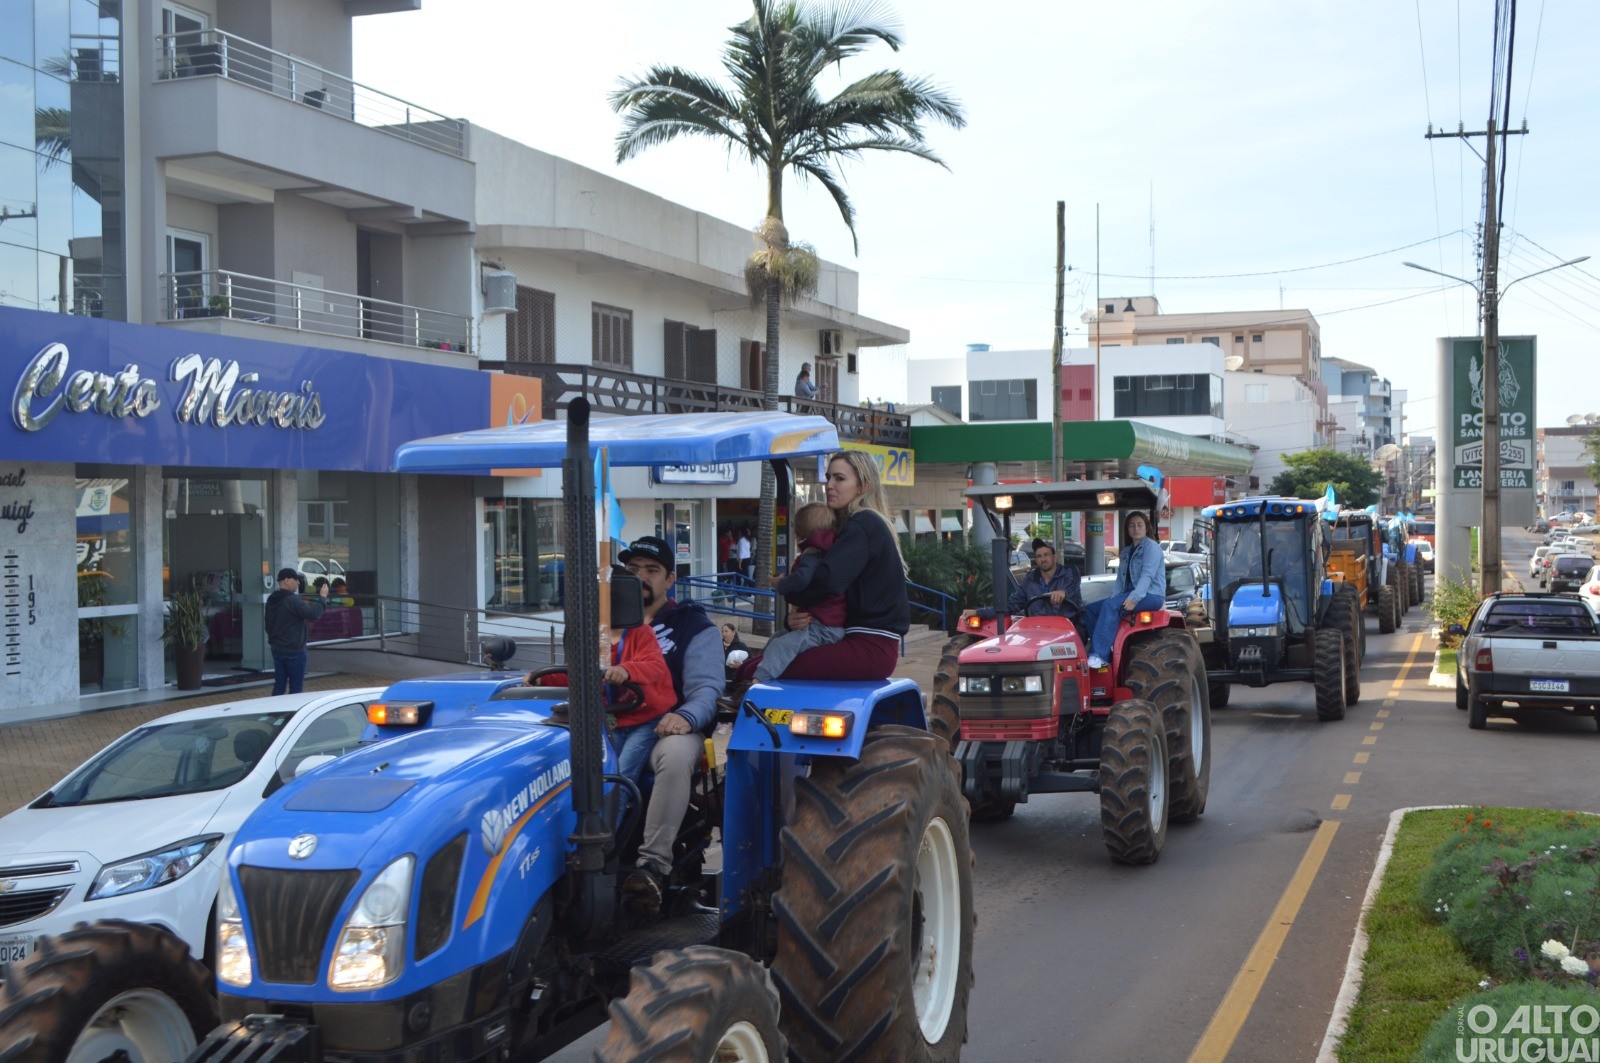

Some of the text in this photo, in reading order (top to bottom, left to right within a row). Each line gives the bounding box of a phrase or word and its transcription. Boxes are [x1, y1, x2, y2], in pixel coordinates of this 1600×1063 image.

[12, 342, 327, 432] Certo Móveis
[1461, 412, 1526, 426] POTO
[1500, 425, 1526, 437] INÊS
[885, 449, 909, 483] 20
[1461, 470, 1525, 478] LANERIA
[1458, 478, 1527, 487] & CHERIA
[502, 758, 572, 830] NEW HOLLAND
